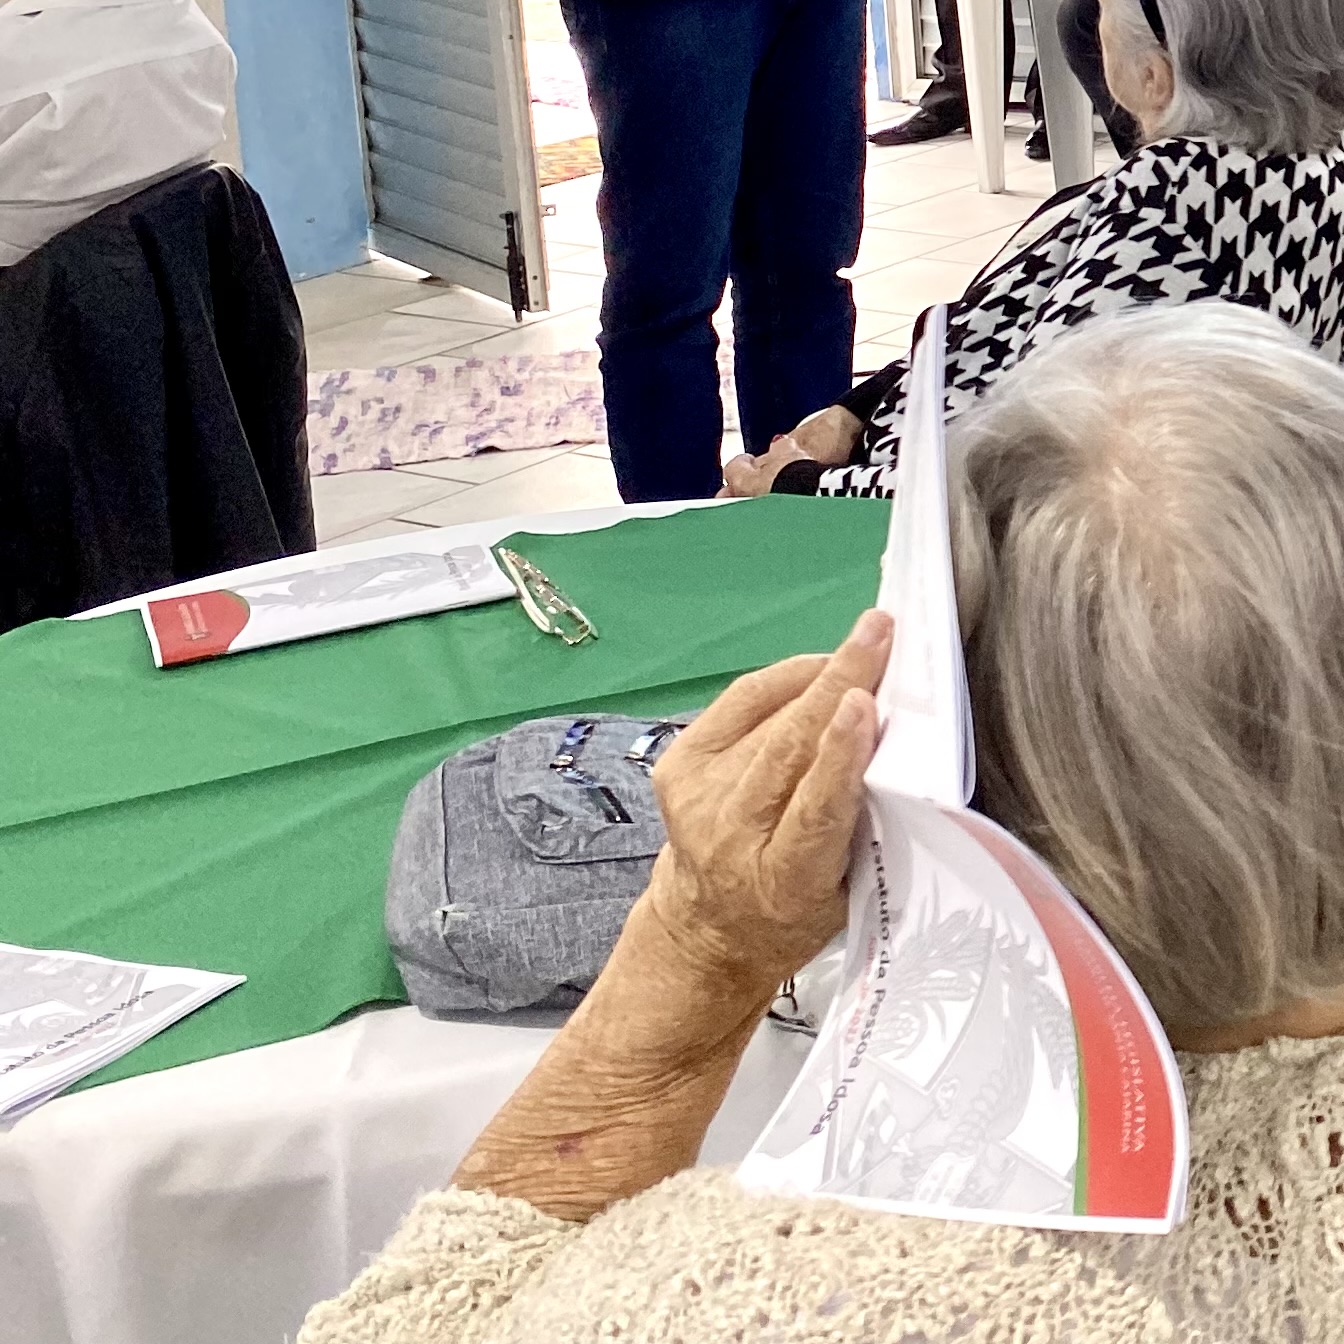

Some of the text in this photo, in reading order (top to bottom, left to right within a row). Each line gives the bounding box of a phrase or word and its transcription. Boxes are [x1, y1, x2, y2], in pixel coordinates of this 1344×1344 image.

[877, 950, 890, 979] da
[849, 989, 886, 1069] Pessoa
[809, 1078, 855, 1136] Idosa
